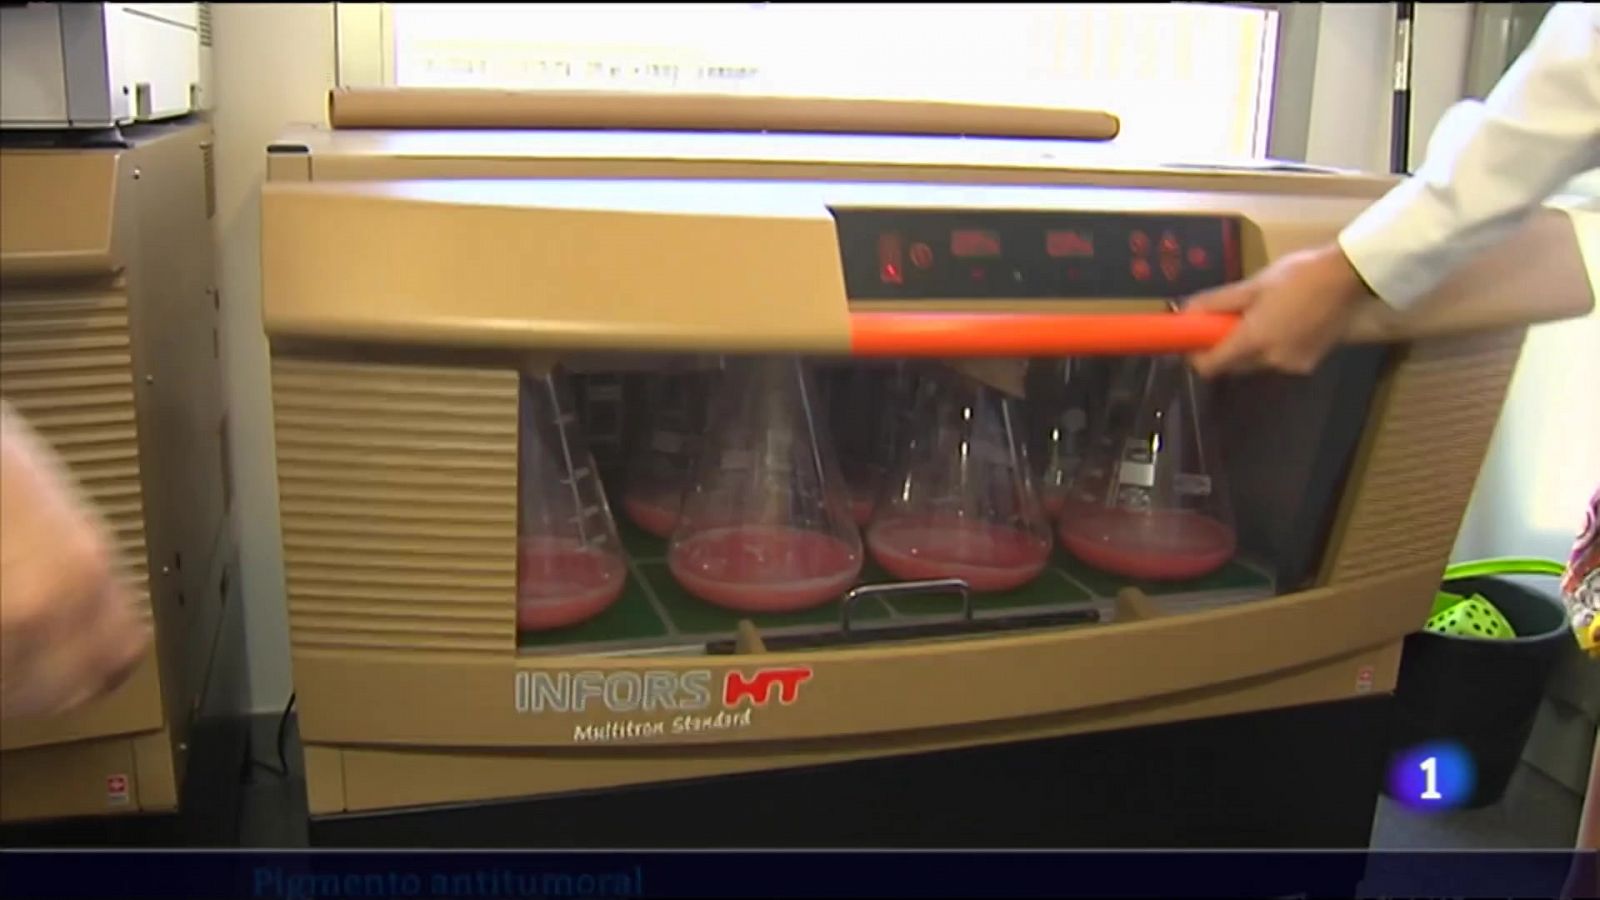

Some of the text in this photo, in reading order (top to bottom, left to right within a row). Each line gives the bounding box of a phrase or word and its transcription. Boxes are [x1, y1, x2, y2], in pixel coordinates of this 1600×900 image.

[515, 667, 813, 712] INFORS HT
[573, 708, 752, 742] Multitron Standard
